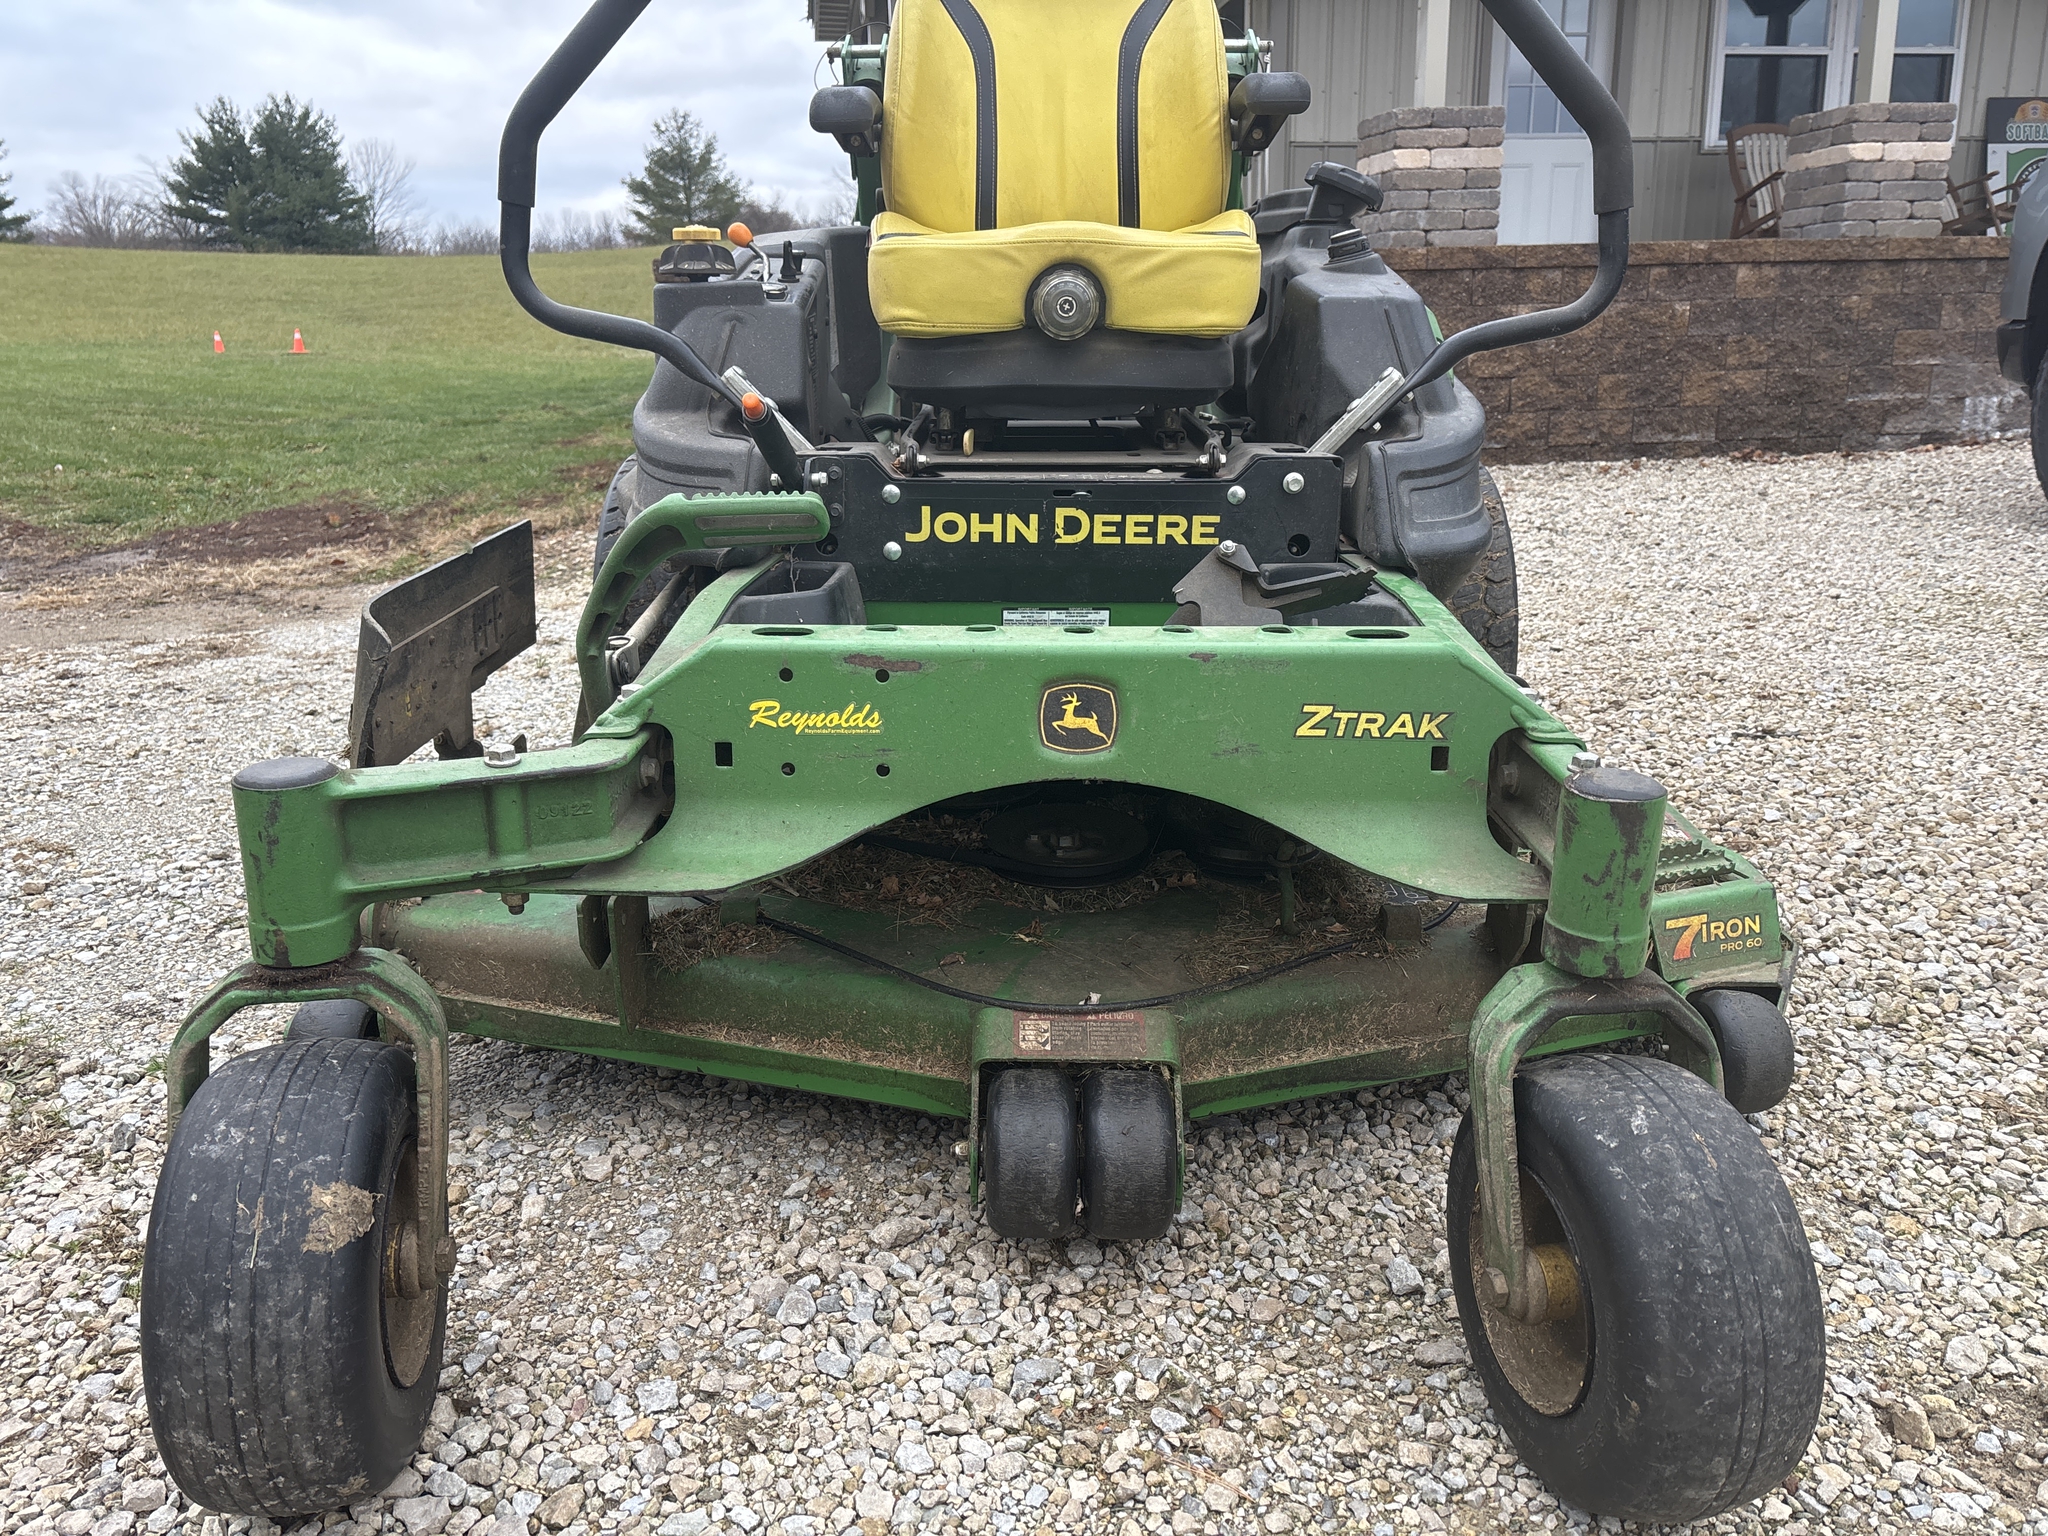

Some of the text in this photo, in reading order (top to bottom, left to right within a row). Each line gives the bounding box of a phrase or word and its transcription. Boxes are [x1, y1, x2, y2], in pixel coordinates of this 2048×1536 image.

[905, 506, 1221, 545] JOHN DEERE
[748, 699, 883, 735] Reynolds
[1295, 704, 1452, 740] ZTRAK
[1720, 937, 1762, 954] PRO 60
